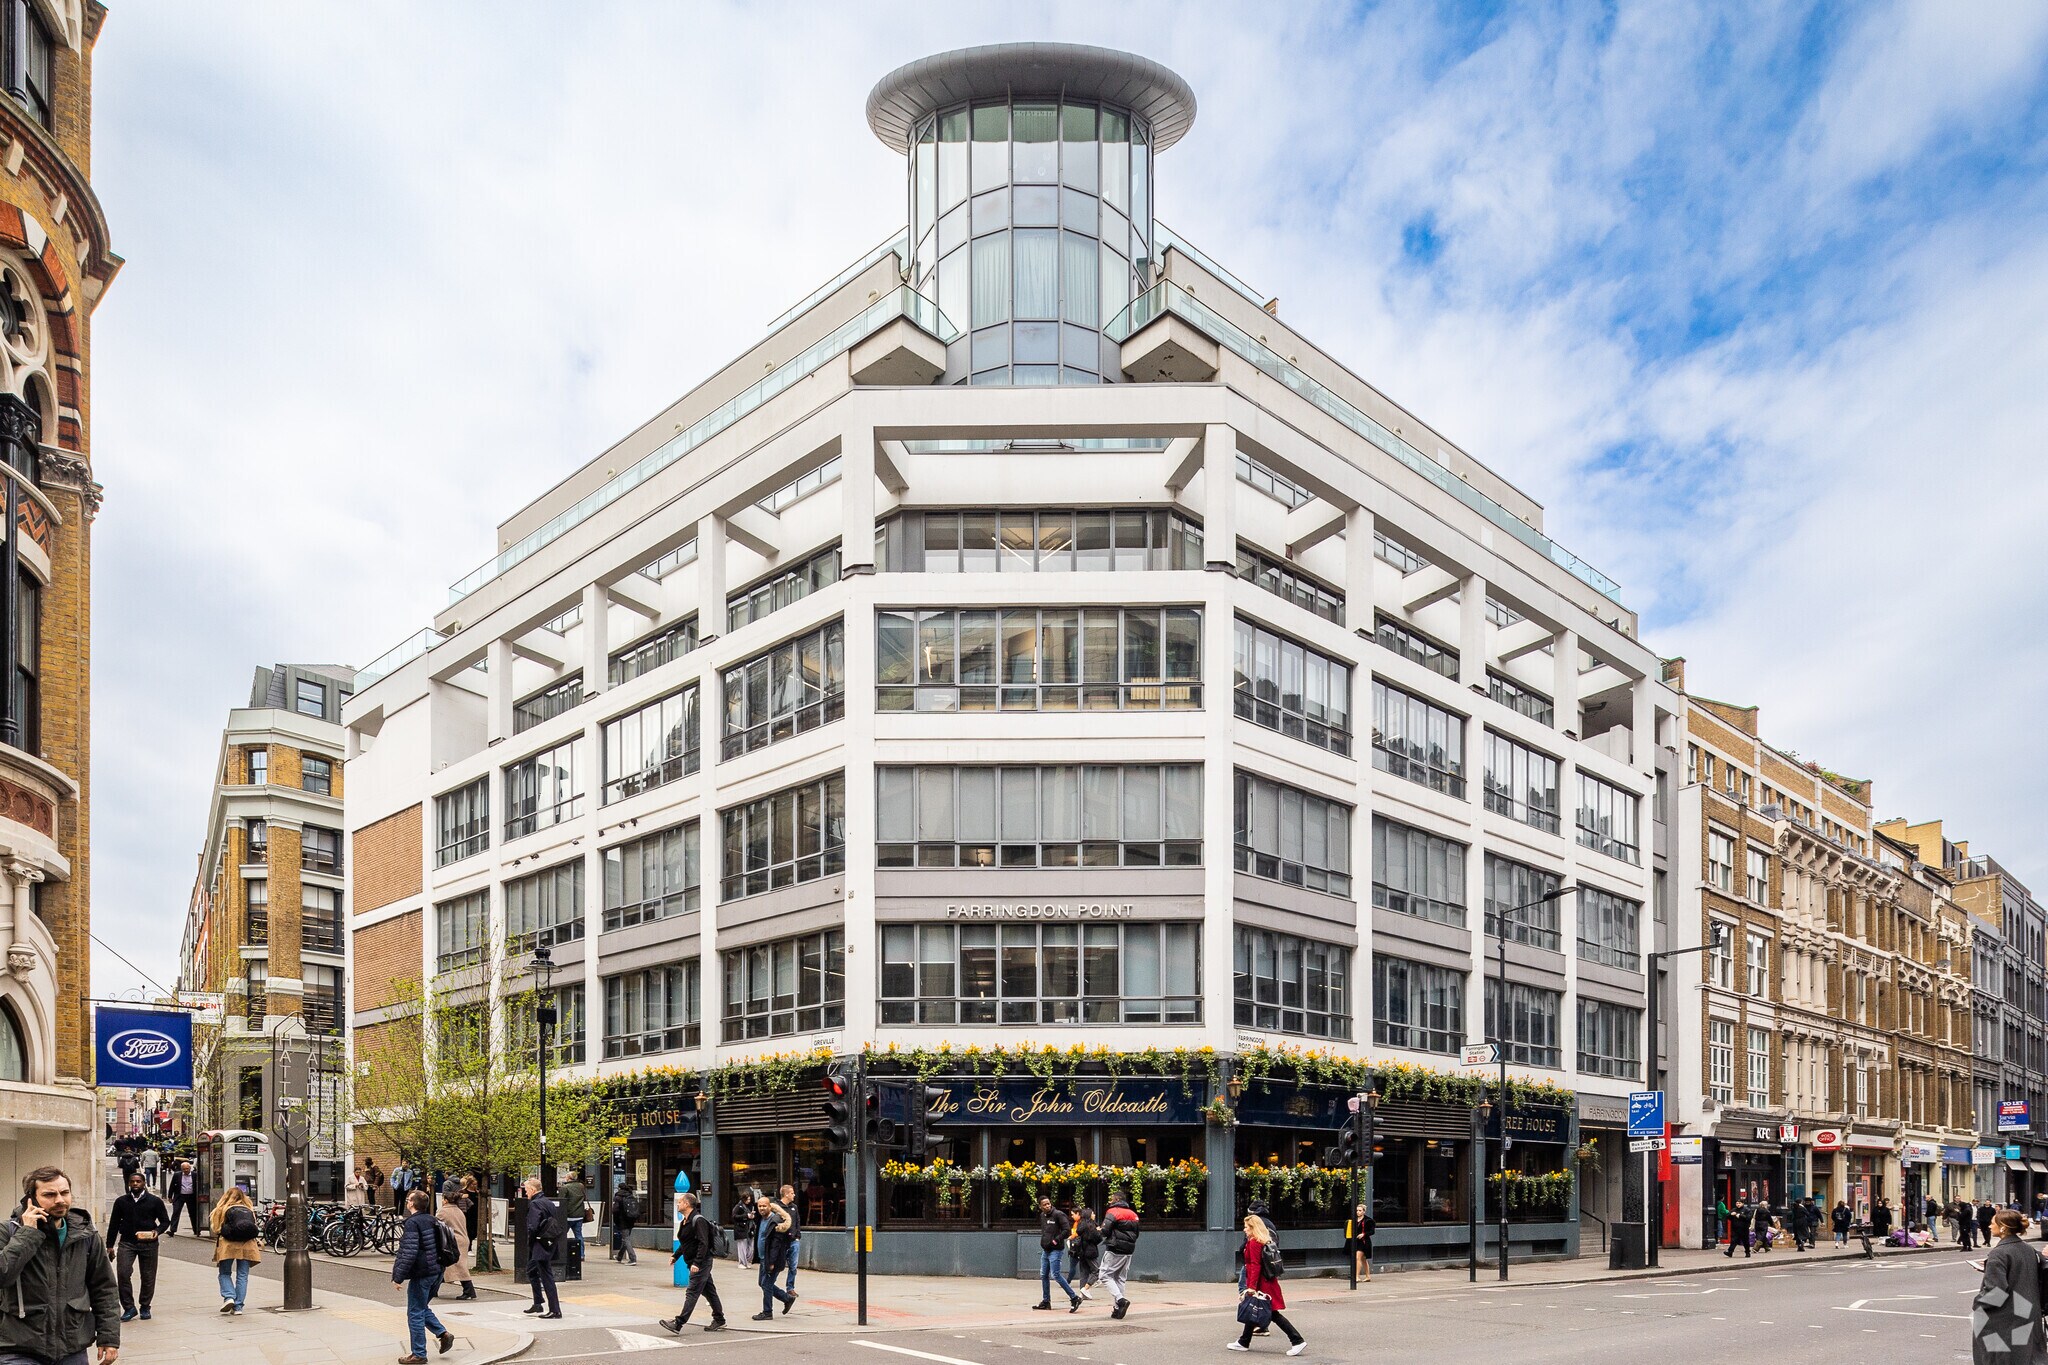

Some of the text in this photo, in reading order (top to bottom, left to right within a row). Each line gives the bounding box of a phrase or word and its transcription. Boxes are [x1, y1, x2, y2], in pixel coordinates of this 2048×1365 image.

[946, 904, 1133, 917] FARRINGDON POINT
[120, 1038, 169, 1059] Boots
[813, 1037, 835, 1046] GREVILLE
[279, 1033, 292, 1128] HATTON
[928, 1088, 1168, 1123] The Sir John Oldcastle
[1589, 1107, 1627, 1120] FARRINGDON
[611, 1109, 681, 1127] FREE HOUSE
[1505, 1116, 1556, 1133] REE HOUSE
[1756, 1127, 1771, 1139] KFC
